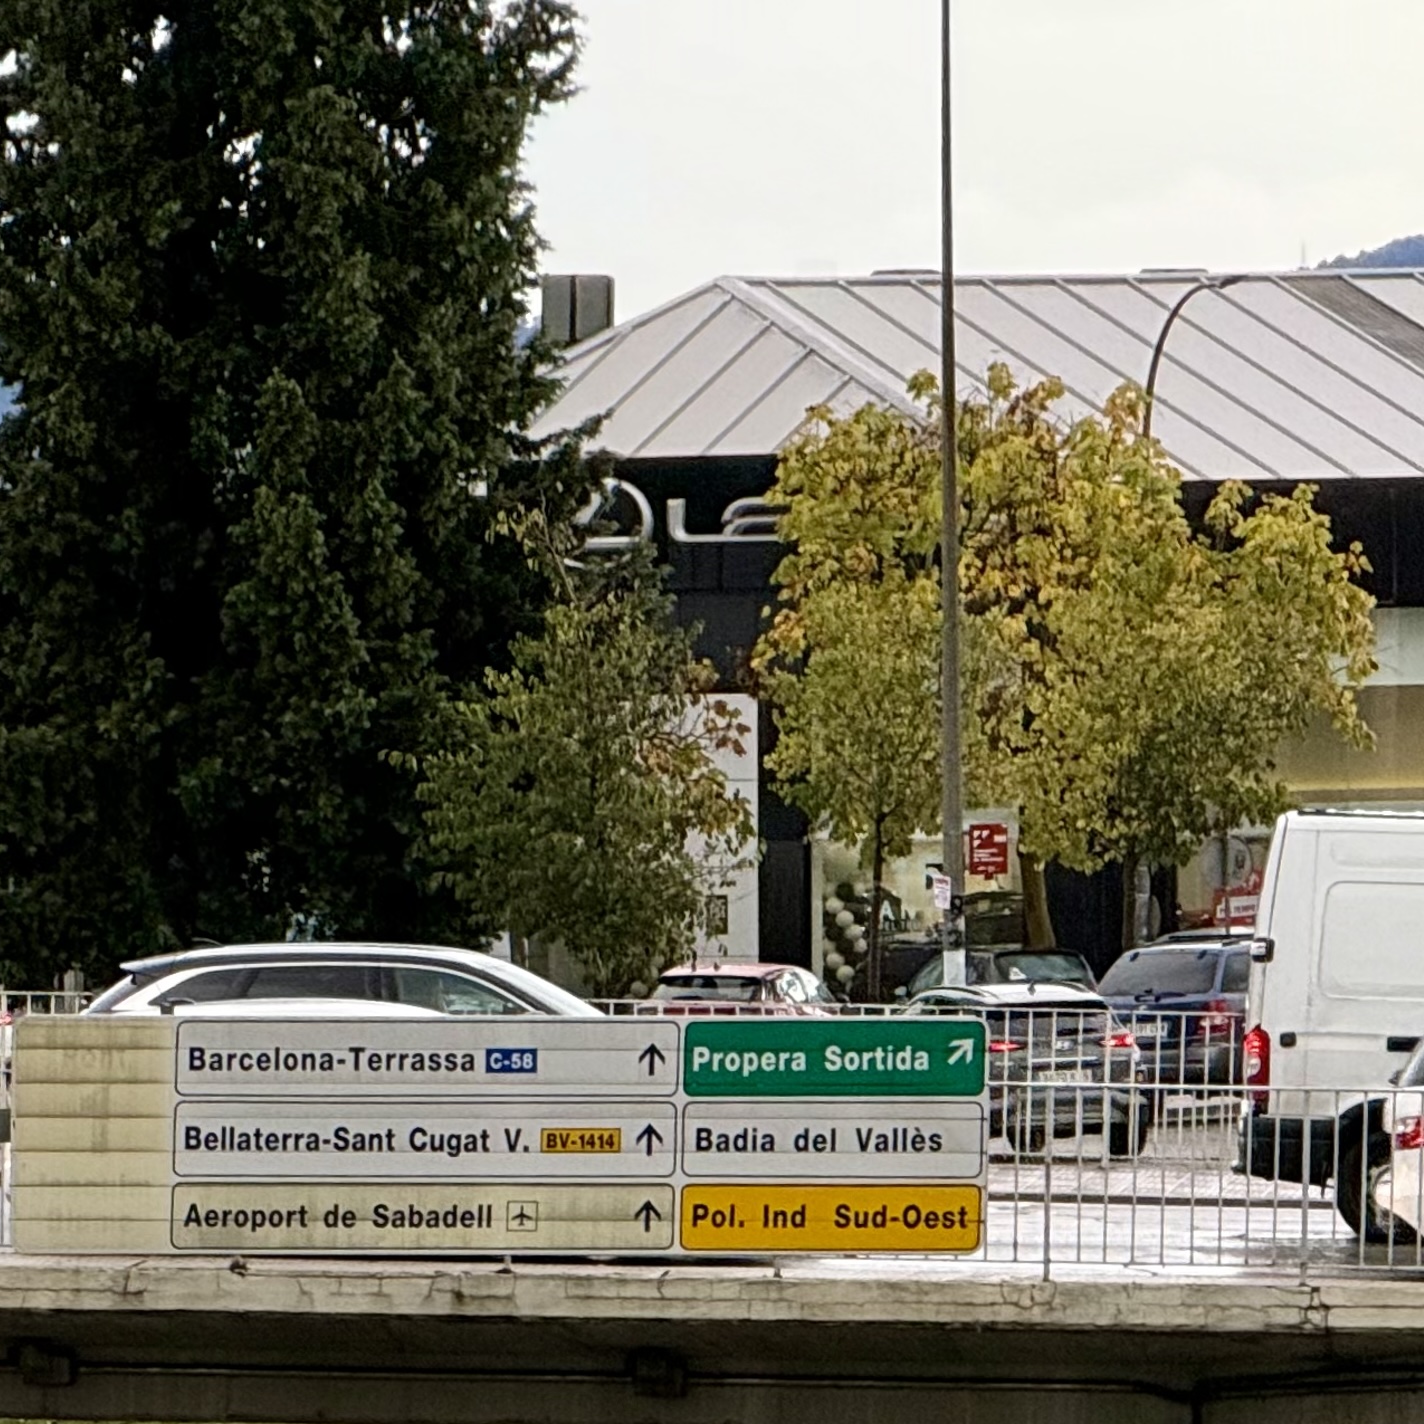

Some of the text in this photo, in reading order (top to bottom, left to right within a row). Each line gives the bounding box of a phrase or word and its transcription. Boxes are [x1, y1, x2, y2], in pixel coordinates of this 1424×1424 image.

[188, 1046, 535, 1073] Barcelona-Terrassa C-58
[692, 1045, 930, 1077] Propera Sortida
[184, 1126, 615, 1157] Bellaterra-Sant Cugat V. BV-1414
[695, 1127, 943, 1152] Badia del Vallès
[183, 1203, 493, 1232] Aeroport de Sabadell
[691, 1203, 969, 1230] Pol. Ind Sud-Oest
